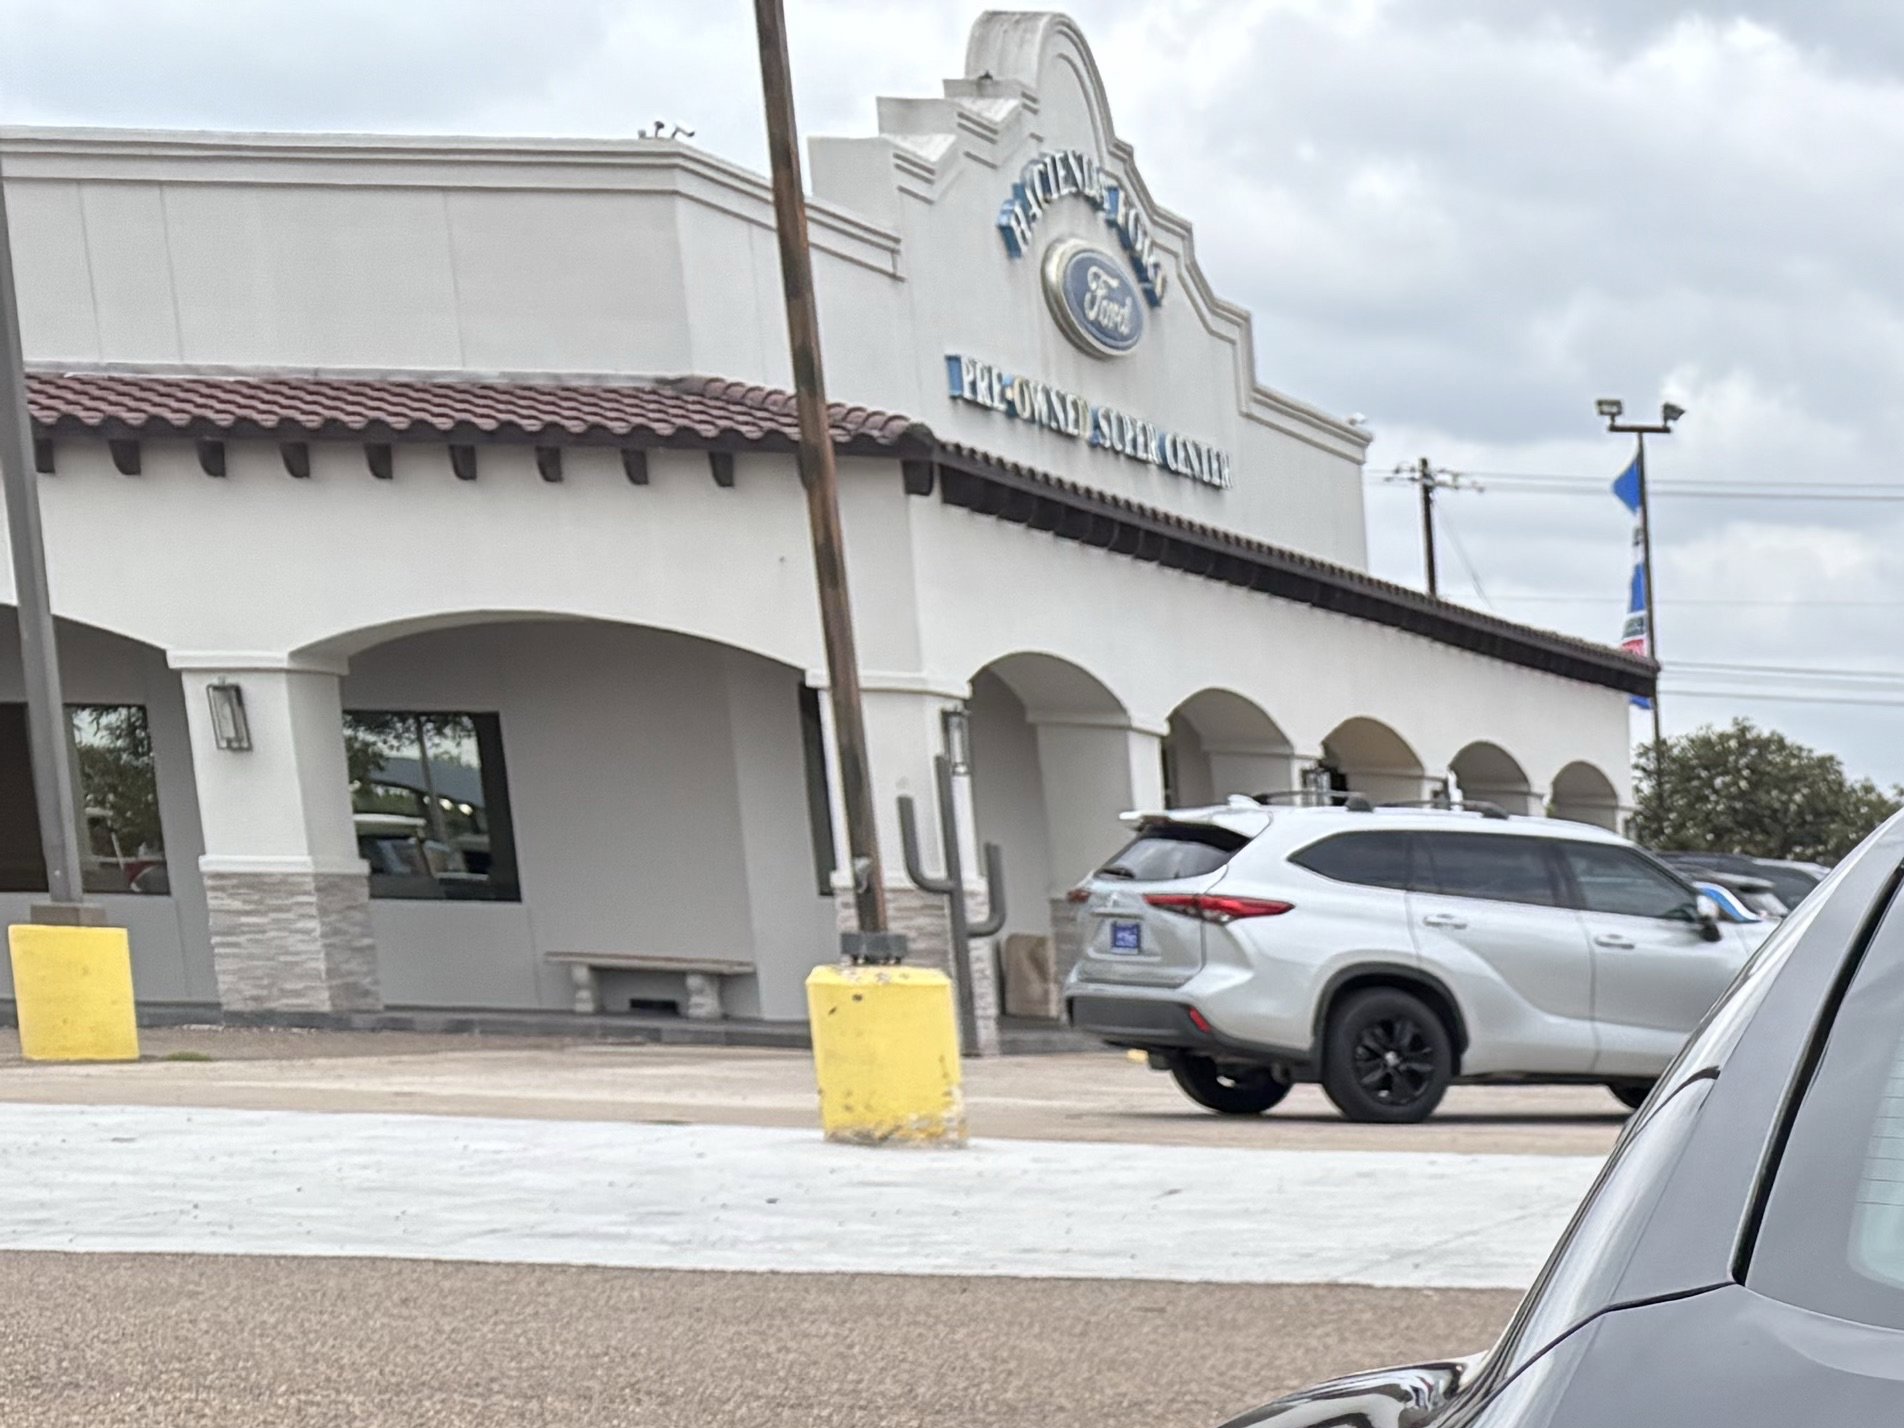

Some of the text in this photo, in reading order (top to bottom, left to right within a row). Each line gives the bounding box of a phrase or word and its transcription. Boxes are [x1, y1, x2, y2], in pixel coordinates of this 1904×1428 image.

[1083, 263, 1133, 337] Ford
[946, 355, 1234, 489] PRE-OWNED SUPER CENTER
